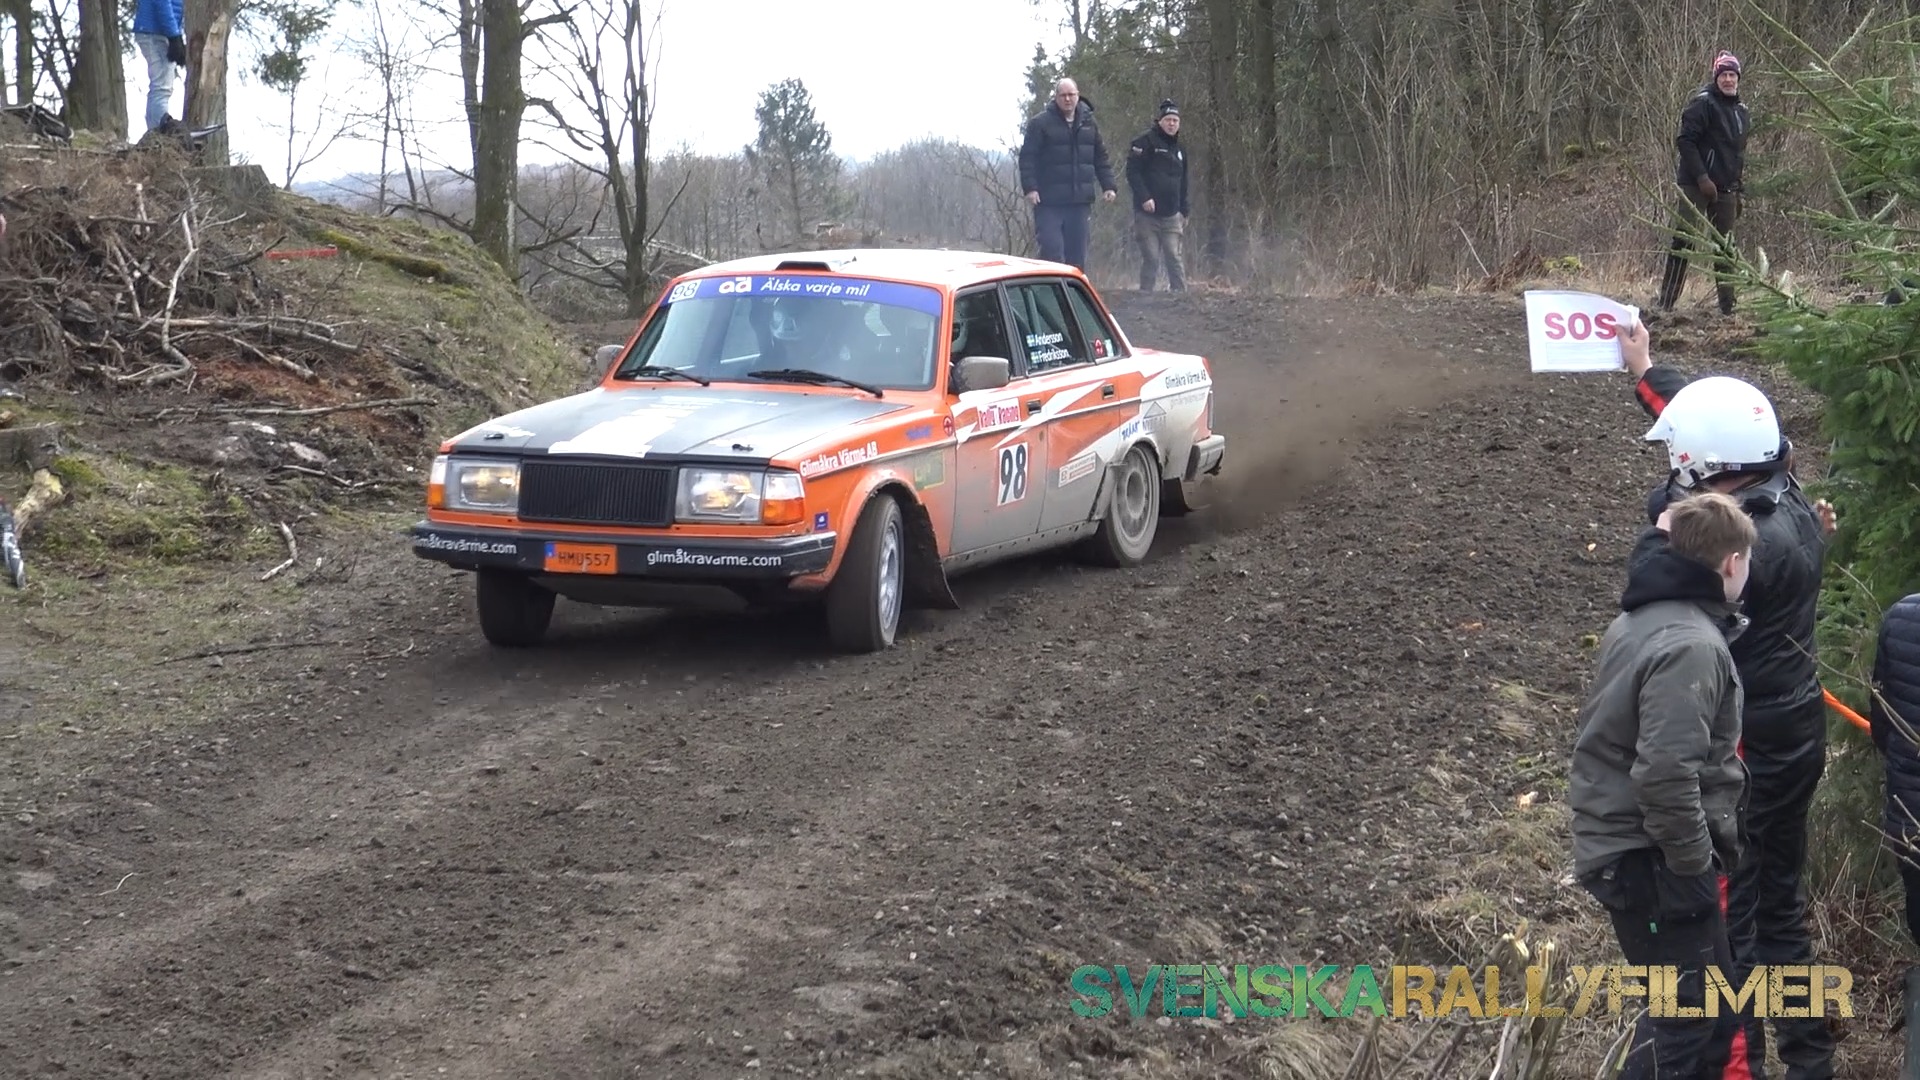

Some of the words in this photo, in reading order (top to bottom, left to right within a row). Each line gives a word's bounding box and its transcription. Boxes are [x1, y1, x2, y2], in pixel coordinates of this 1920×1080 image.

[674, 282, 697, 300] 98
[760, 277, 801, 292] Älska
[805, 281, 842, 296] varje
[845, 284, 871, 296] mil
[1544, 312, 1617, 340] SOS
[1034, 332, 1064, 347] Andersson
[1038, 348, 1071, 363] Fredriksson
[800, 453, 839, 476] Glimåkra
[838, 447, 867, 465] Värme
[867, 441, 878, 458] AB
[1001, 444, 1026, 503] 98
